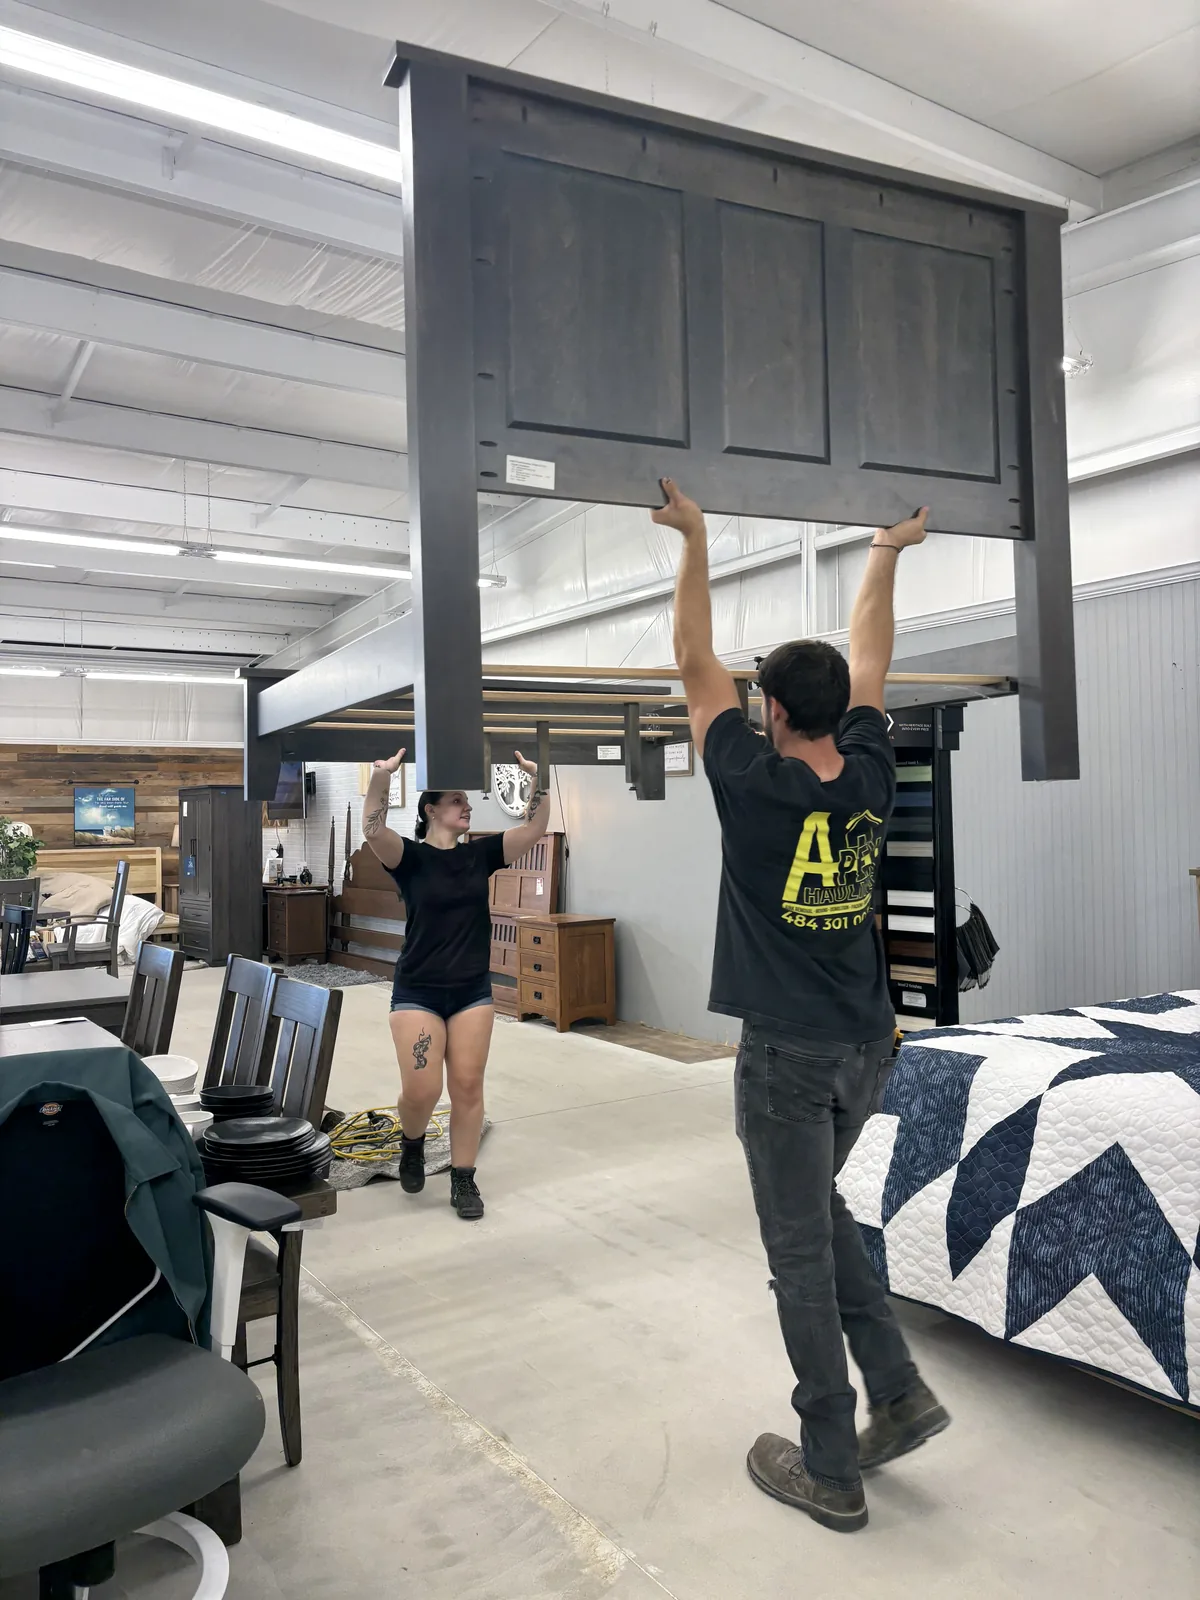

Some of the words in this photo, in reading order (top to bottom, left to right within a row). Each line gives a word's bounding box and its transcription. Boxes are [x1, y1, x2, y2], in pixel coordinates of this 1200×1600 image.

[803, 882, 873, 905] HAULI
[781, 911, 818, 931] 484
[822, 916, 848, 931] 301
